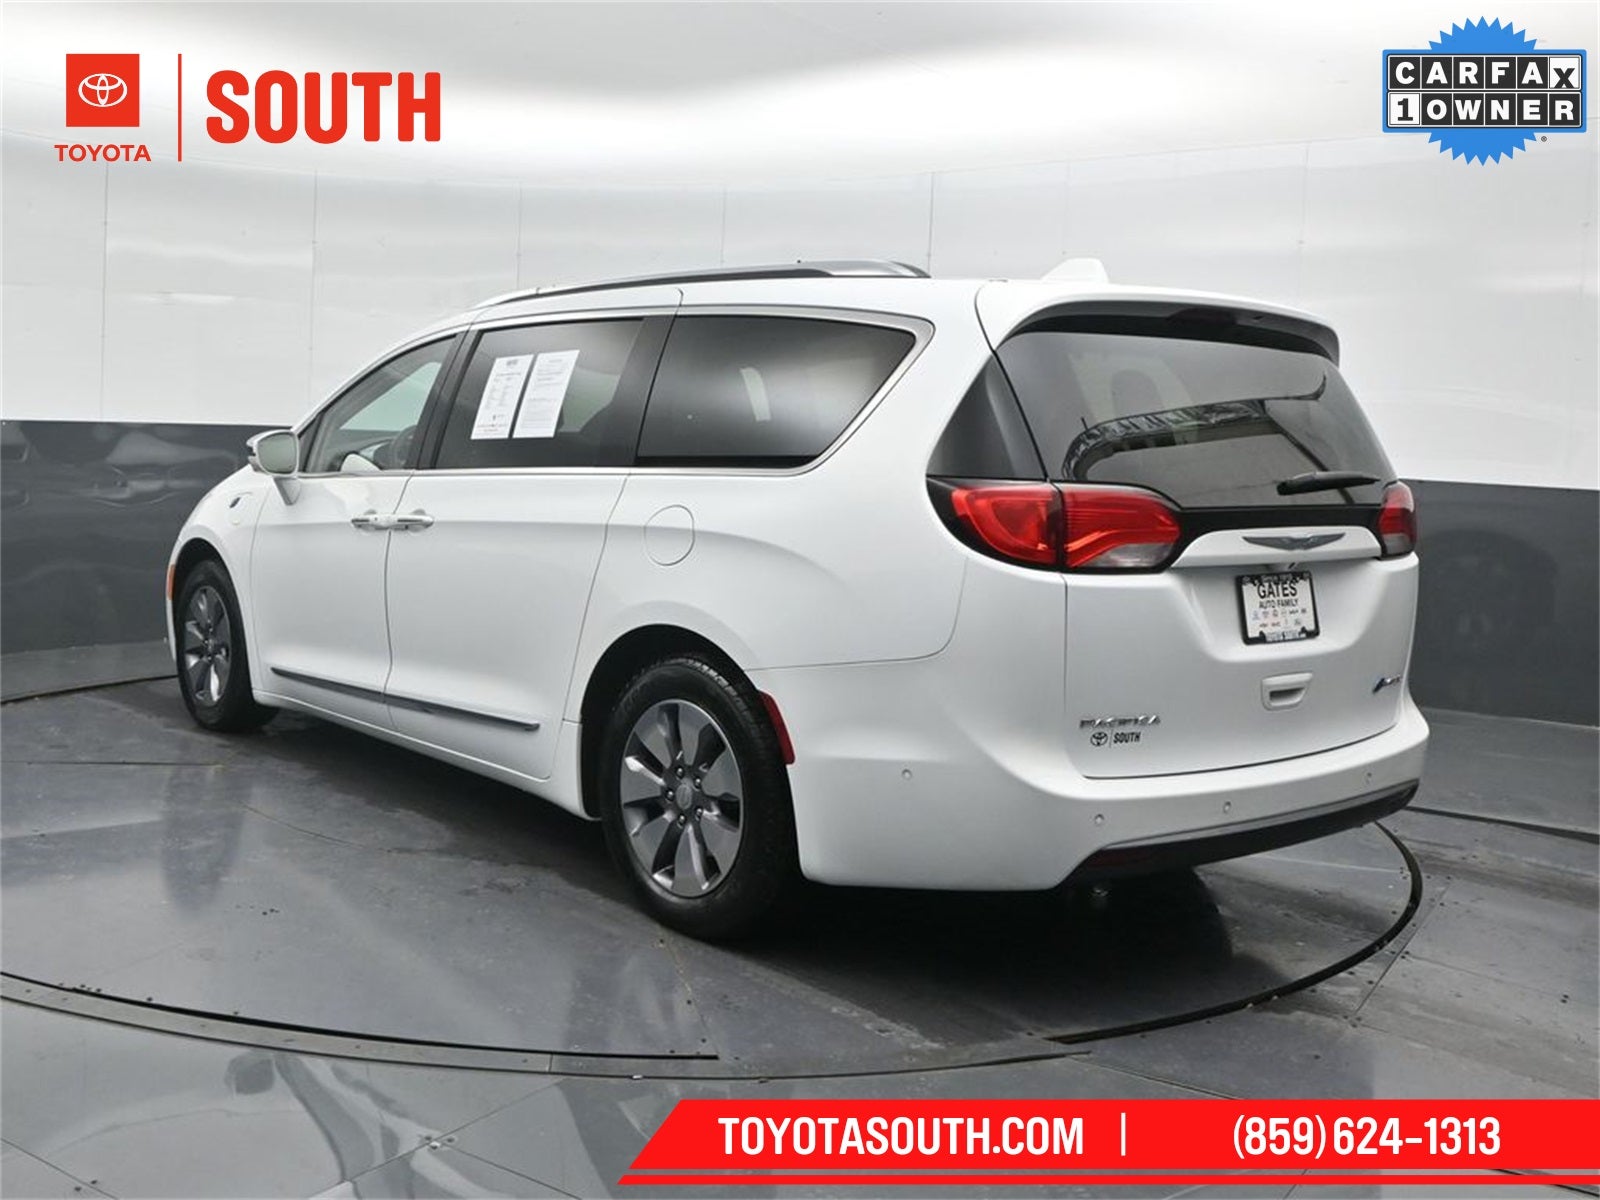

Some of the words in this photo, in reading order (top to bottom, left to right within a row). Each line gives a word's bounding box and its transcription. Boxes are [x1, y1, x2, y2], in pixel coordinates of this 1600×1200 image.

[1257, 582, 1298, 599] GATES
[1259, 600, 1276, 609] AUTO
[1277, 599, 1299, 608] FAMILY
[1113, 732, 1141, 743] SOUTH
